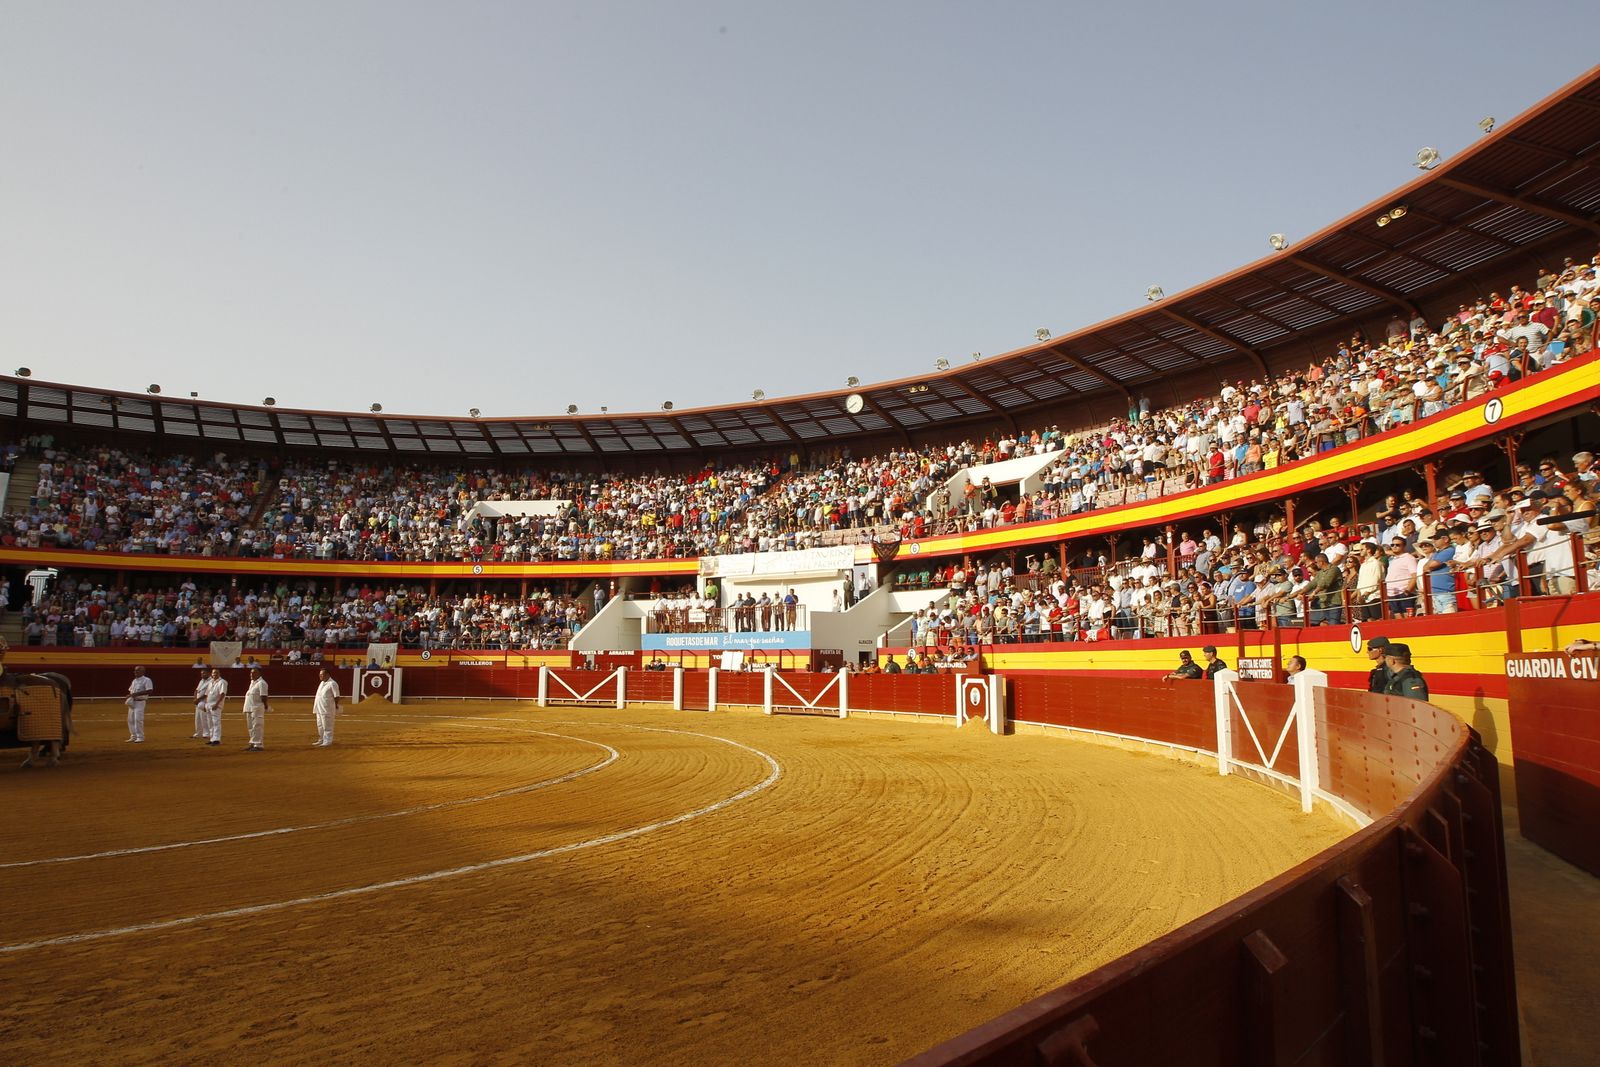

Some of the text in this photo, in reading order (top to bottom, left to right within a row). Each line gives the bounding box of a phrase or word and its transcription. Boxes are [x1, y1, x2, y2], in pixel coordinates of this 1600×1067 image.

[1488, 401, 1498, 420] 7
[1353, 630, 1359, 649] 7
[1239, 668, 1273, 679] CARPINTERO
[1506, 658, 1568, 678] GUARDIA
